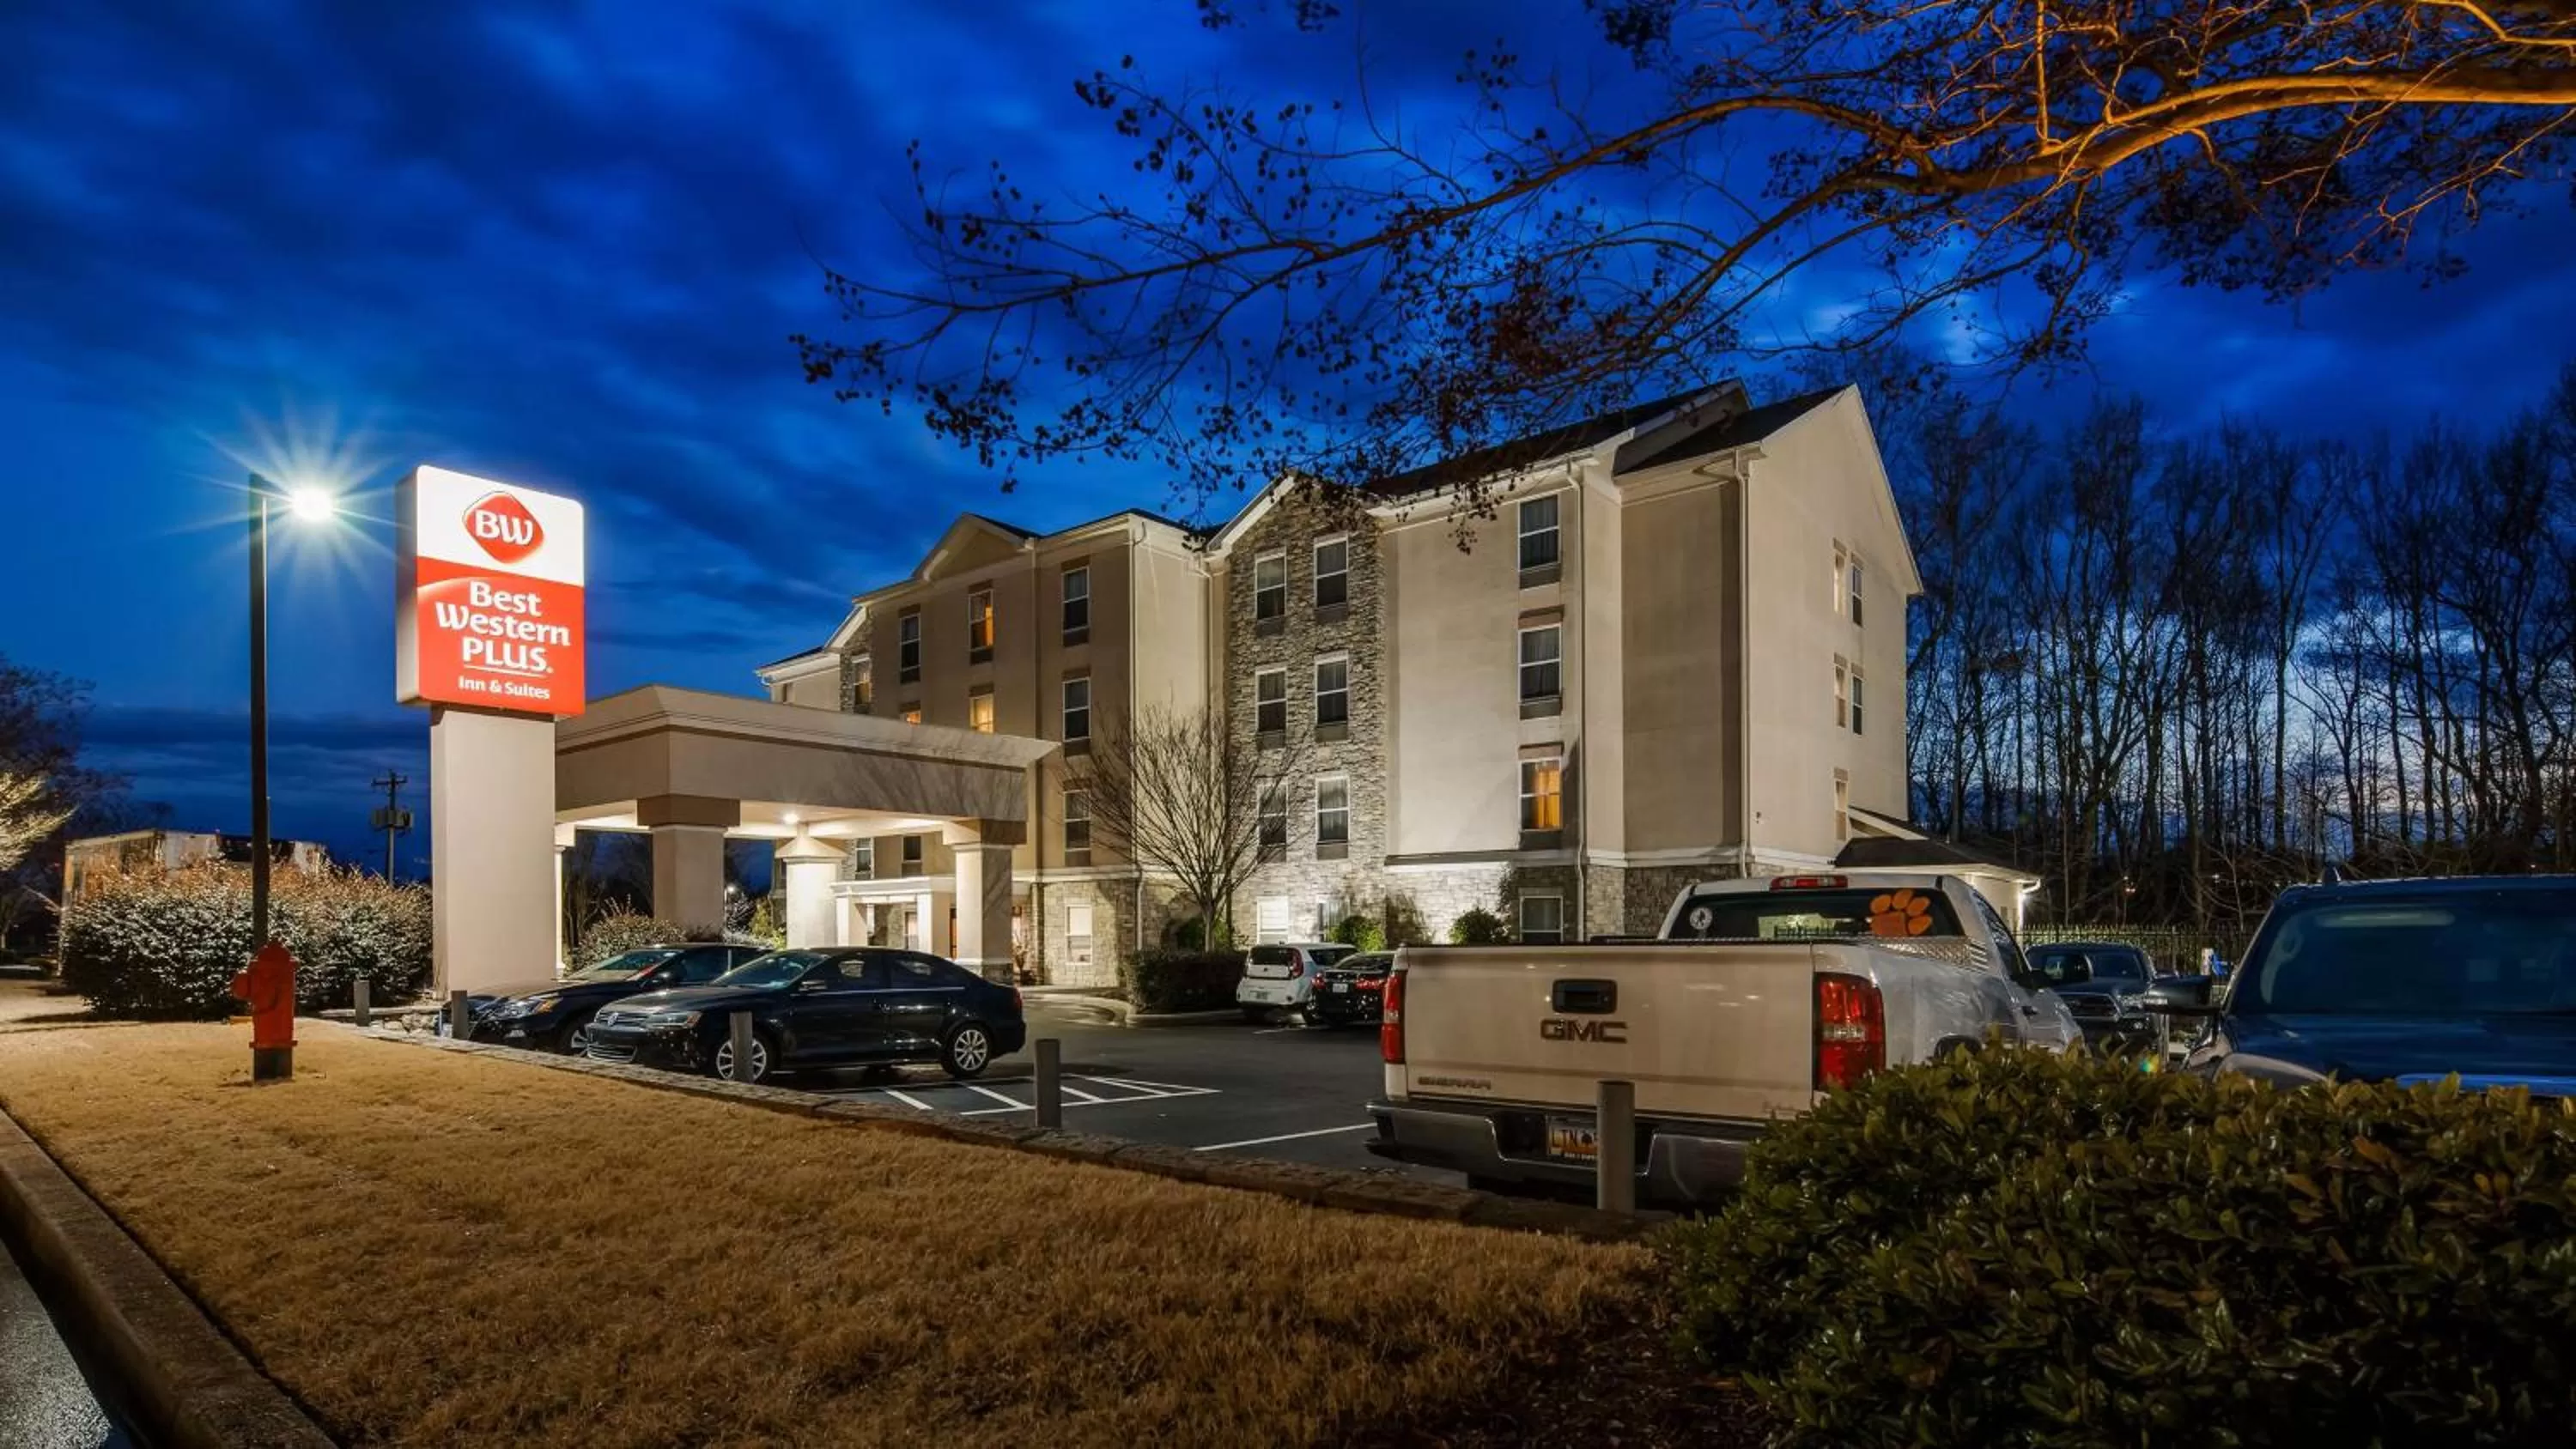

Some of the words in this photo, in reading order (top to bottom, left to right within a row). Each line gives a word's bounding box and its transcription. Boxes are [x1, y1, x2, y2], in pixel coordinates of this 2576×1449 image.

[475, 509, 533, 545] BW
[471, 581, 542, 616] Best
[435, 603, 570, 646] Western
[459, 676, 485, 691] Inn
[489, 680, 502, 694] &
[504, 682, 550, 700] Suites
[1540, 1019, 1628, 1044] GMC
